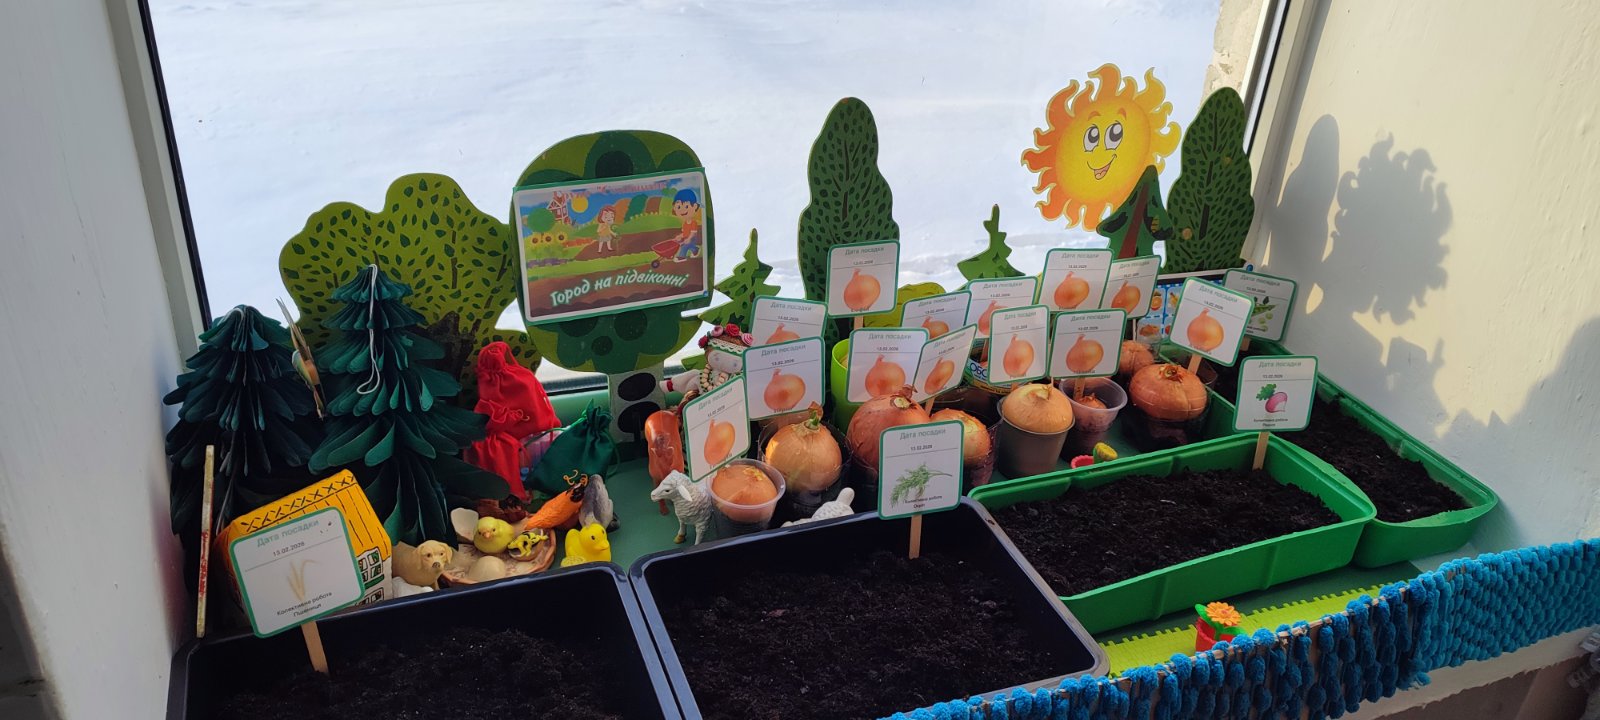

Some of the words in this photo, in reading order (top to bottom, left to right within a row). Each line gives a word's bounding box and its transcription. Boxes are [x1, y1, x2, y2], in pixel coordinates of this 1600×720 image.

[845, 247, 860, 255] Дата
[1240, 274, 1255, 282] Дата
[1256, 277, 1280, 287] посадки
[550, 279, 591, 307] Город
[594, 275, 611, 290] на
[615, 269, 689, 288] підвіконні
[1199, 285, 1213, 295] Дата
[1214, 290, 1238, 303] посадки
[770, 301, 786, 310] Дата
[787, 303, 812, 311] посадки
[761, 348, 778, 357] Дата
[779, 344, 806, 354] посадки
[900, 432, 917, 440] Дата
[918, 428, 946, 437] посадки
[257, 534, 280, 548] Дата
[281, 520, 320, 537] посадки
[277, 599, 312, 616] Колективна
[312, 592, 332, 604] робота
